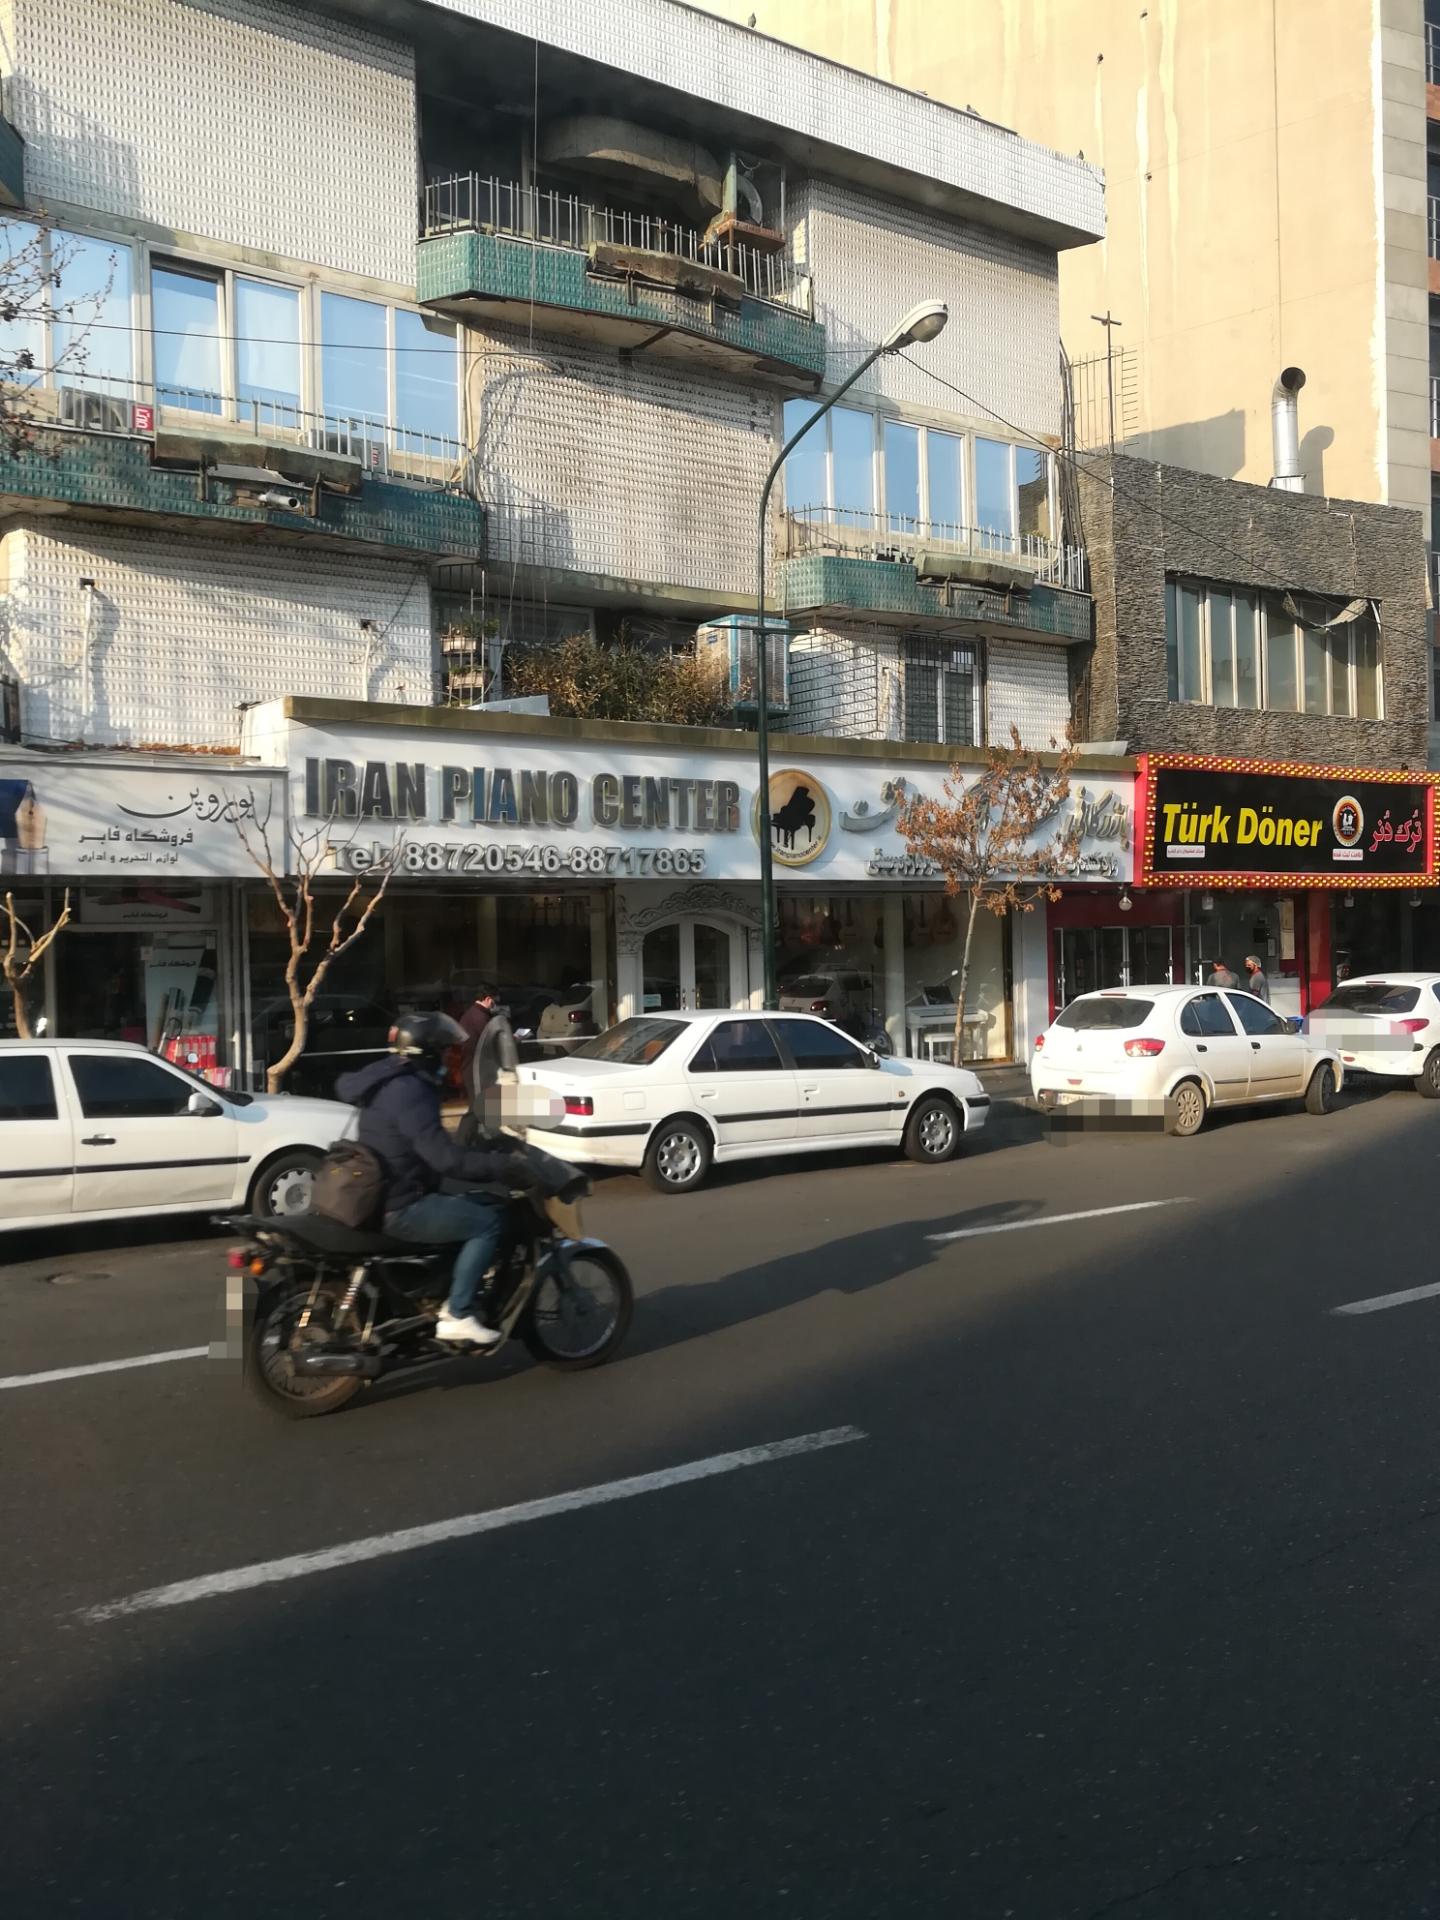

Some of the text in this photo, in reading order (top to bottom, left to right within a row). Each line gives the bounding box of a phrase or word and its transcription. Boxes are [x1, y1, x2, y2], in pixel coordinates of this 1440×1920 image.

[306, 757, 741, 832] IRAN PIANO CENTER
[79, 825, 193, 846] فروشگاه فابر
[1163, 802, 1232, 843] Türk
[1236, 806, 1323, 847] Döner
[78, 851, 178, 864] لوازم التحریر و اداری
[404, 842, 706, 875] 88720546-88717865
